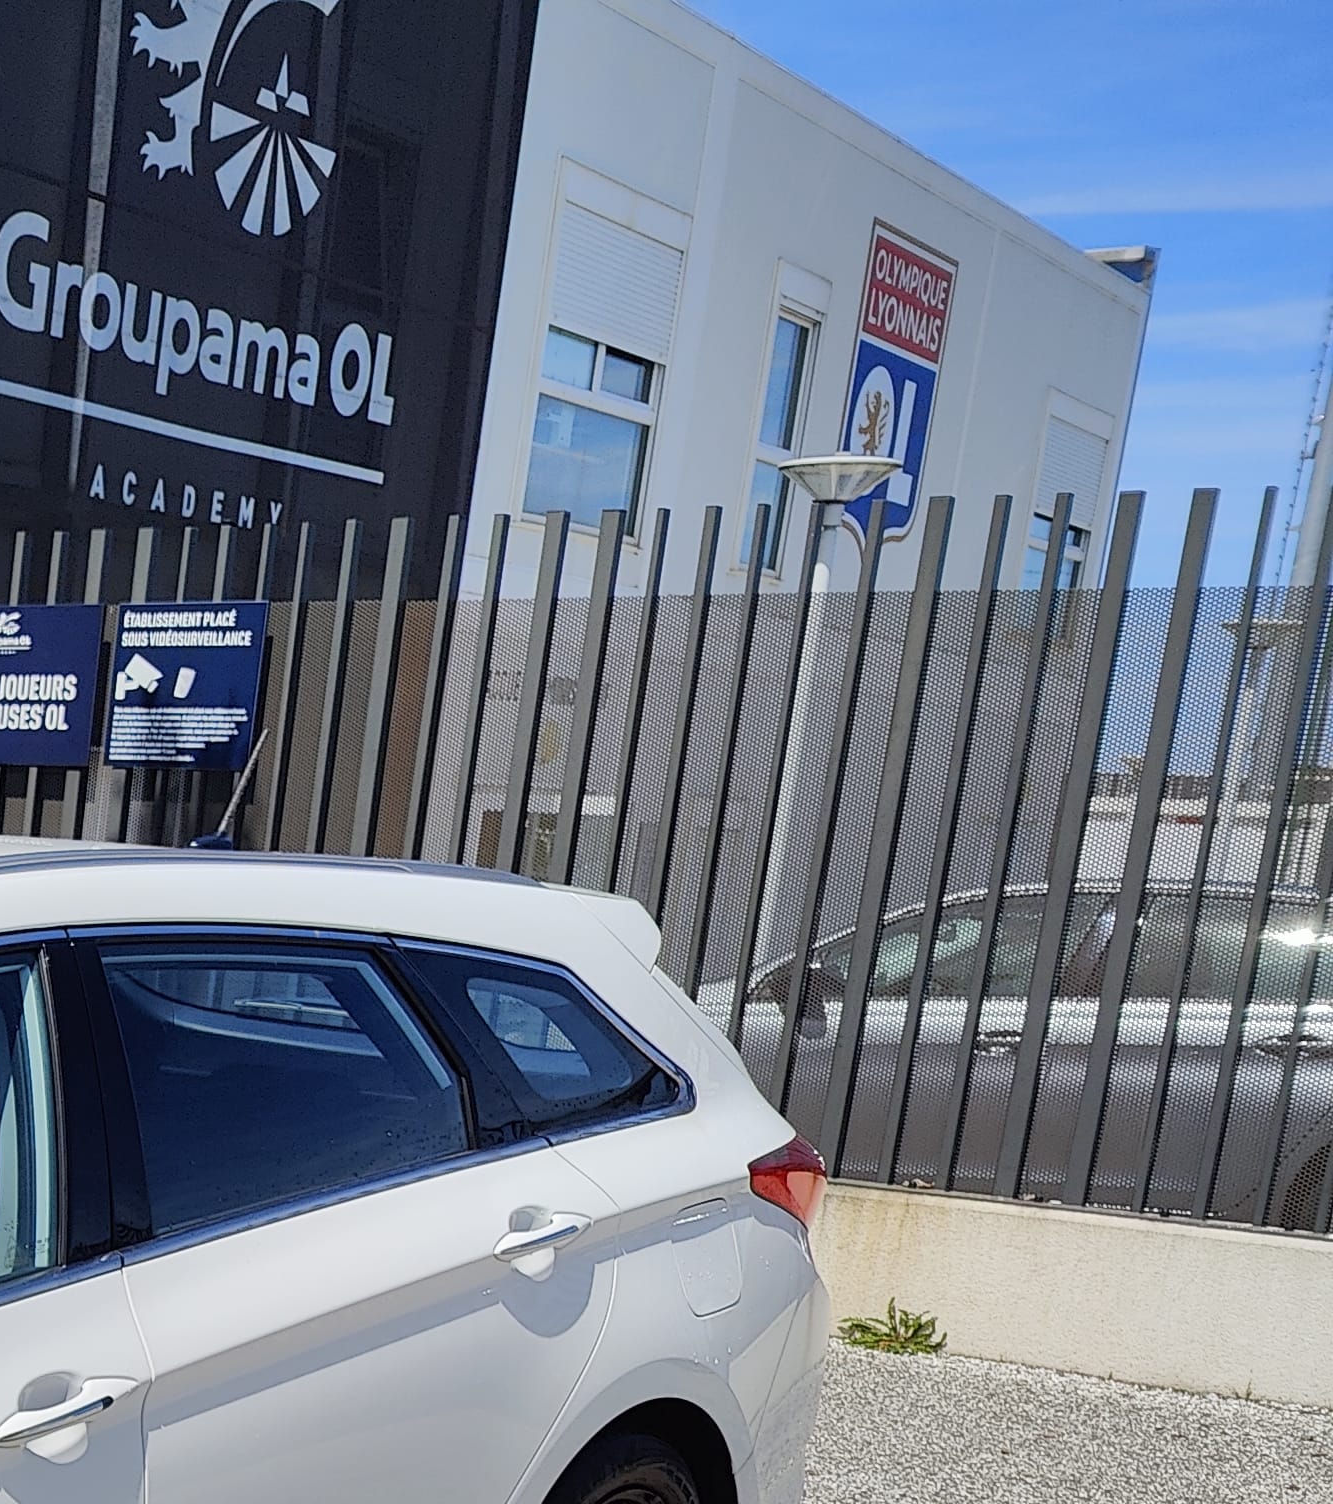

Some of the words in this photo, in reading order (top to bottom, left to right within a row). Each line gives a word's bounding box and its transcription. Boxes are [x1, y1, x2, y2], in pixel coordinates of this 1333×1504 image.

[876, 248, 949, 311] OLYMPIQUE
[867, 287, 942, 352] LYONNAIS
[329, 322, 396, 427] OL
[89, 463, 284, 529] ACADEMY
[121, 631, 149, 647] SOUS
[150, 629, 253, 647] VIDÉOSURVEILLANCE
[123, 610, 202, 628] ÉTABLISSEMENT
[202, 609, 237, 627] PLACÉ
[45, 703, 69, 731] OL
